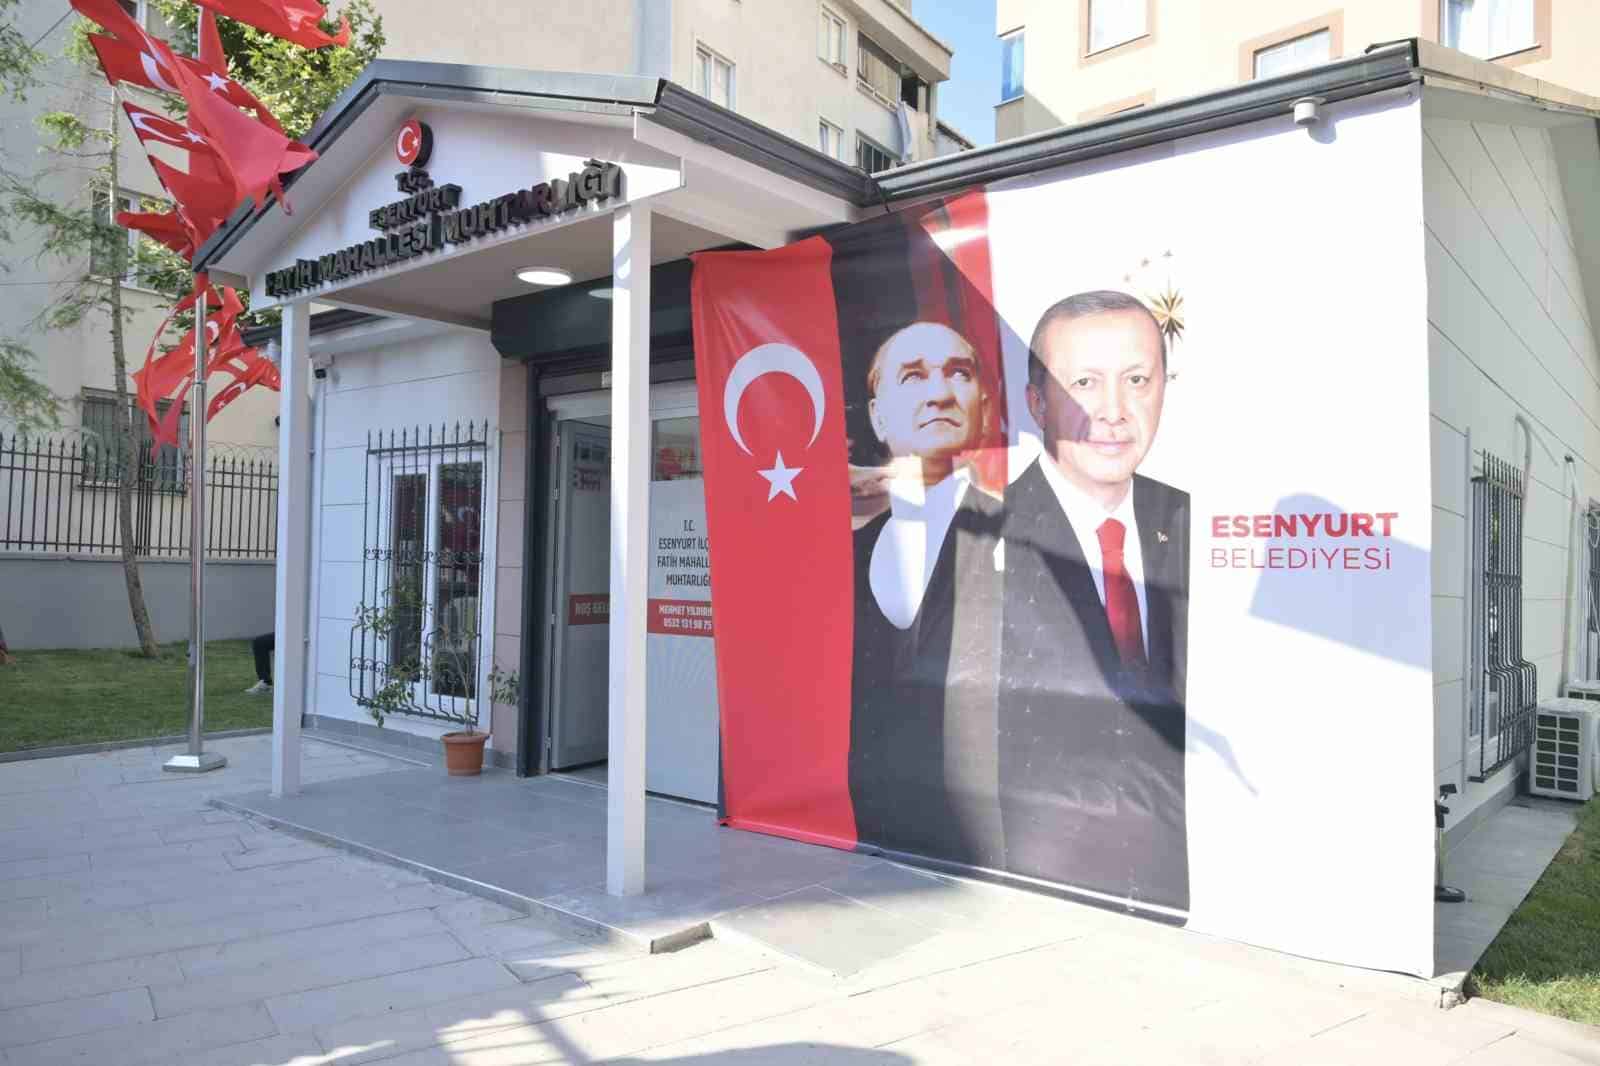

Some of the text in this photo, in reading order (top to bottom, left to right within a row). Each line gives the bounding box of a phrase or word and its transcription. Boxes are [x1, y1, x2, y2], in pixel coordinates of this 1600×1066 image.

[370, 184, 462, 229] ESENYURT
[265, 258, 320, 298] FATİH
[1211, 512, 1399, 538] ESENYURT
[658, 536, 710, 552] ESENYURT İLÇ
[657, 554, 711, 568] FATİH MAHALL
[1211, 547, 1391, 570] BELEDİYESİ
